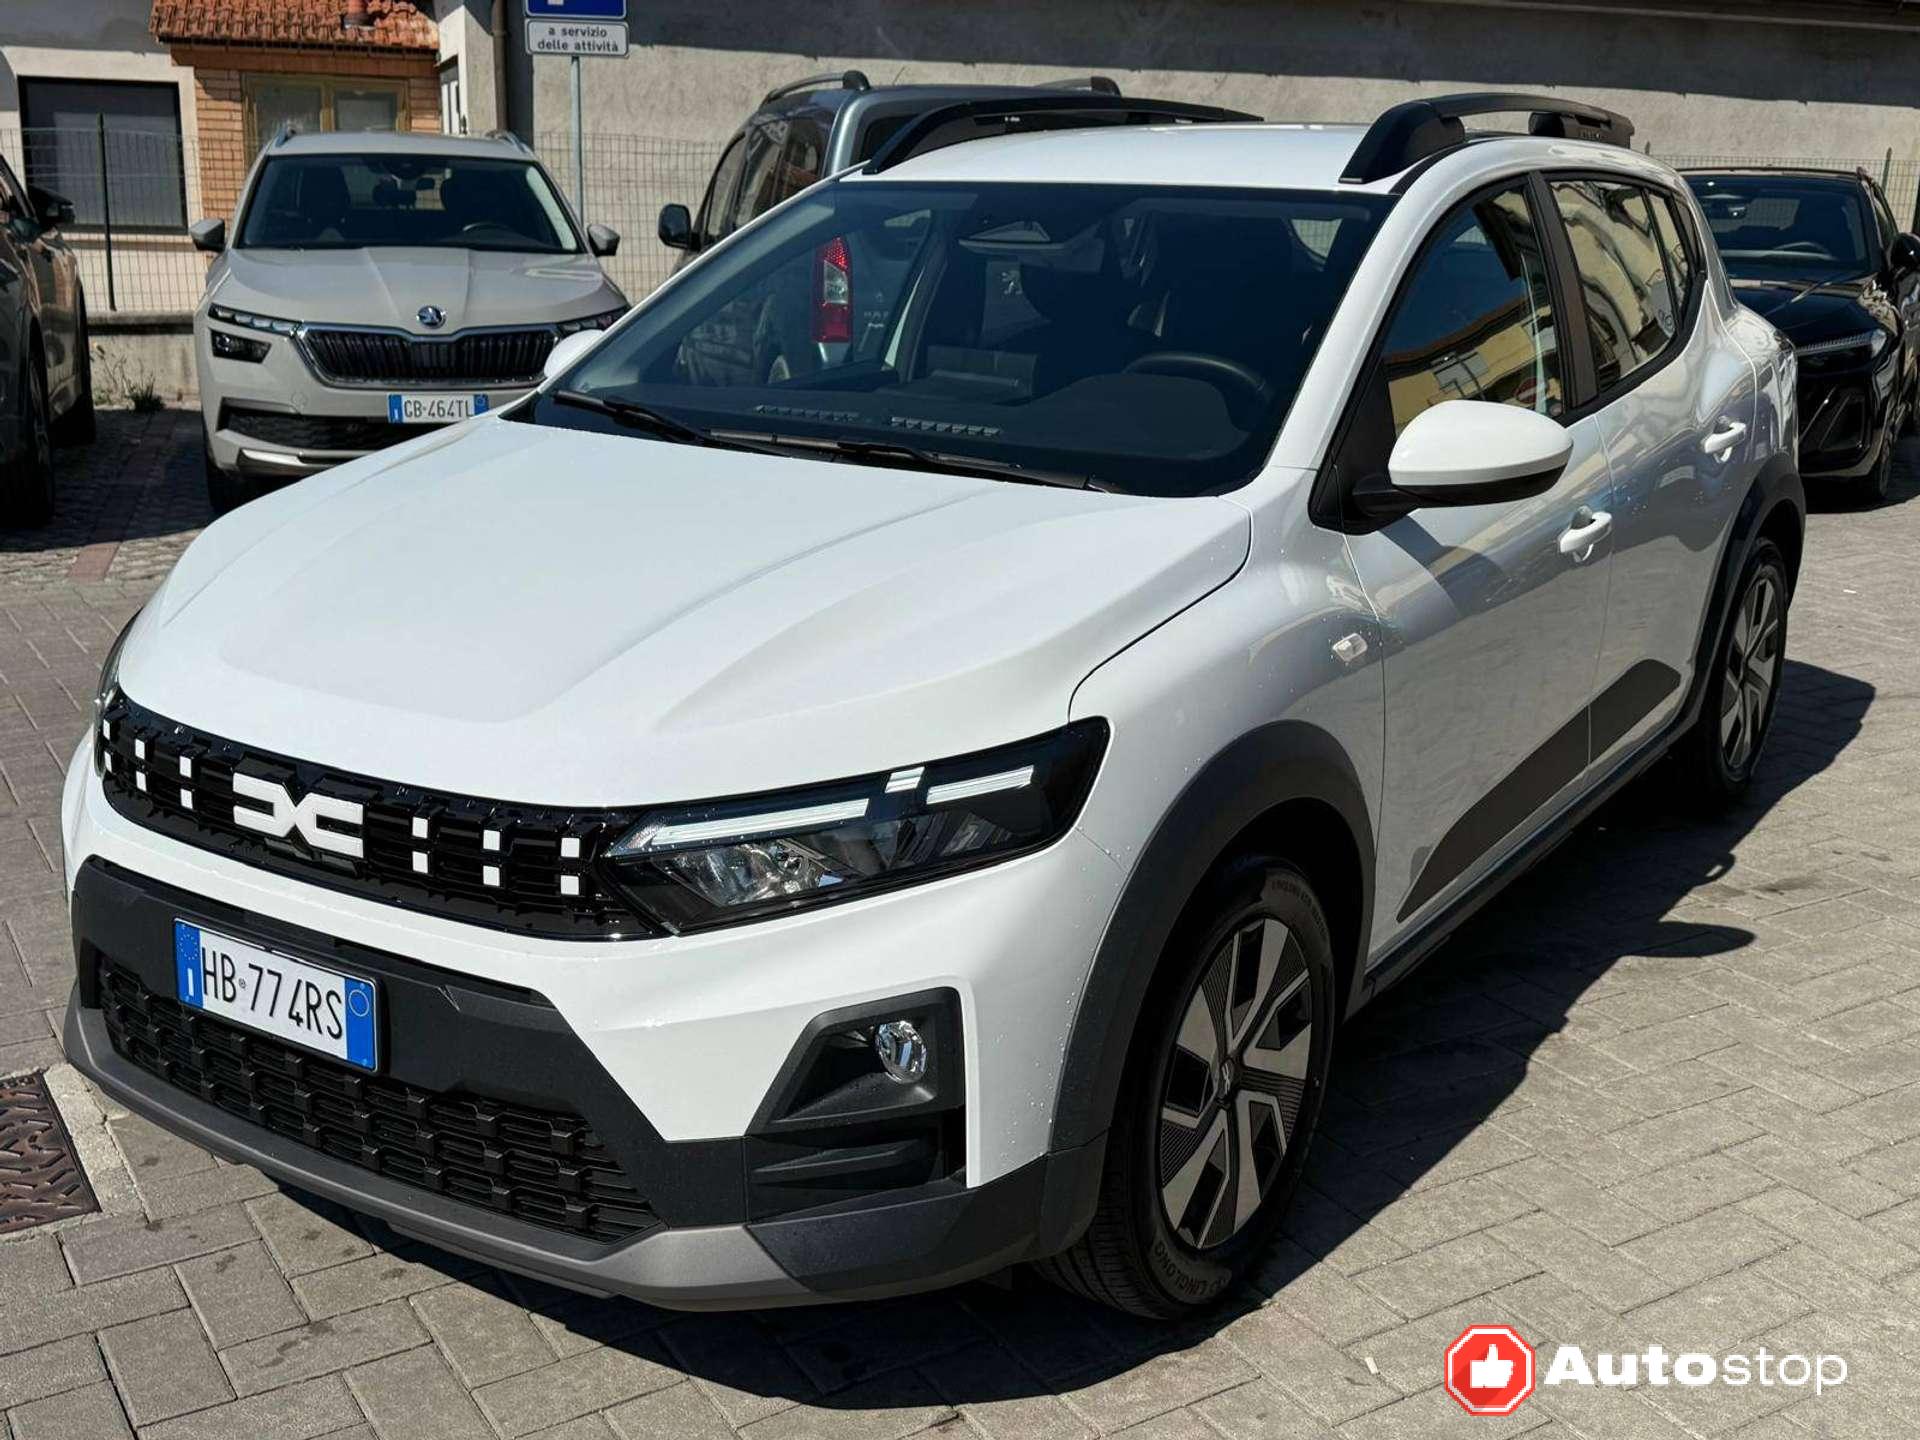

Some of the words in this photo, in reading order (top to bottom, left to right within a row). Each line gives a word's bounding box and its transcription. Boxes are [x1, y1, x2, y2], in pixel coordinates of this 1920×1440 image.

[548, 27, 556, 36] a
[561, 27, 608, 38] servizio
[537, 40, 569, 51] delle
[574, 40, 619, 52] attività
